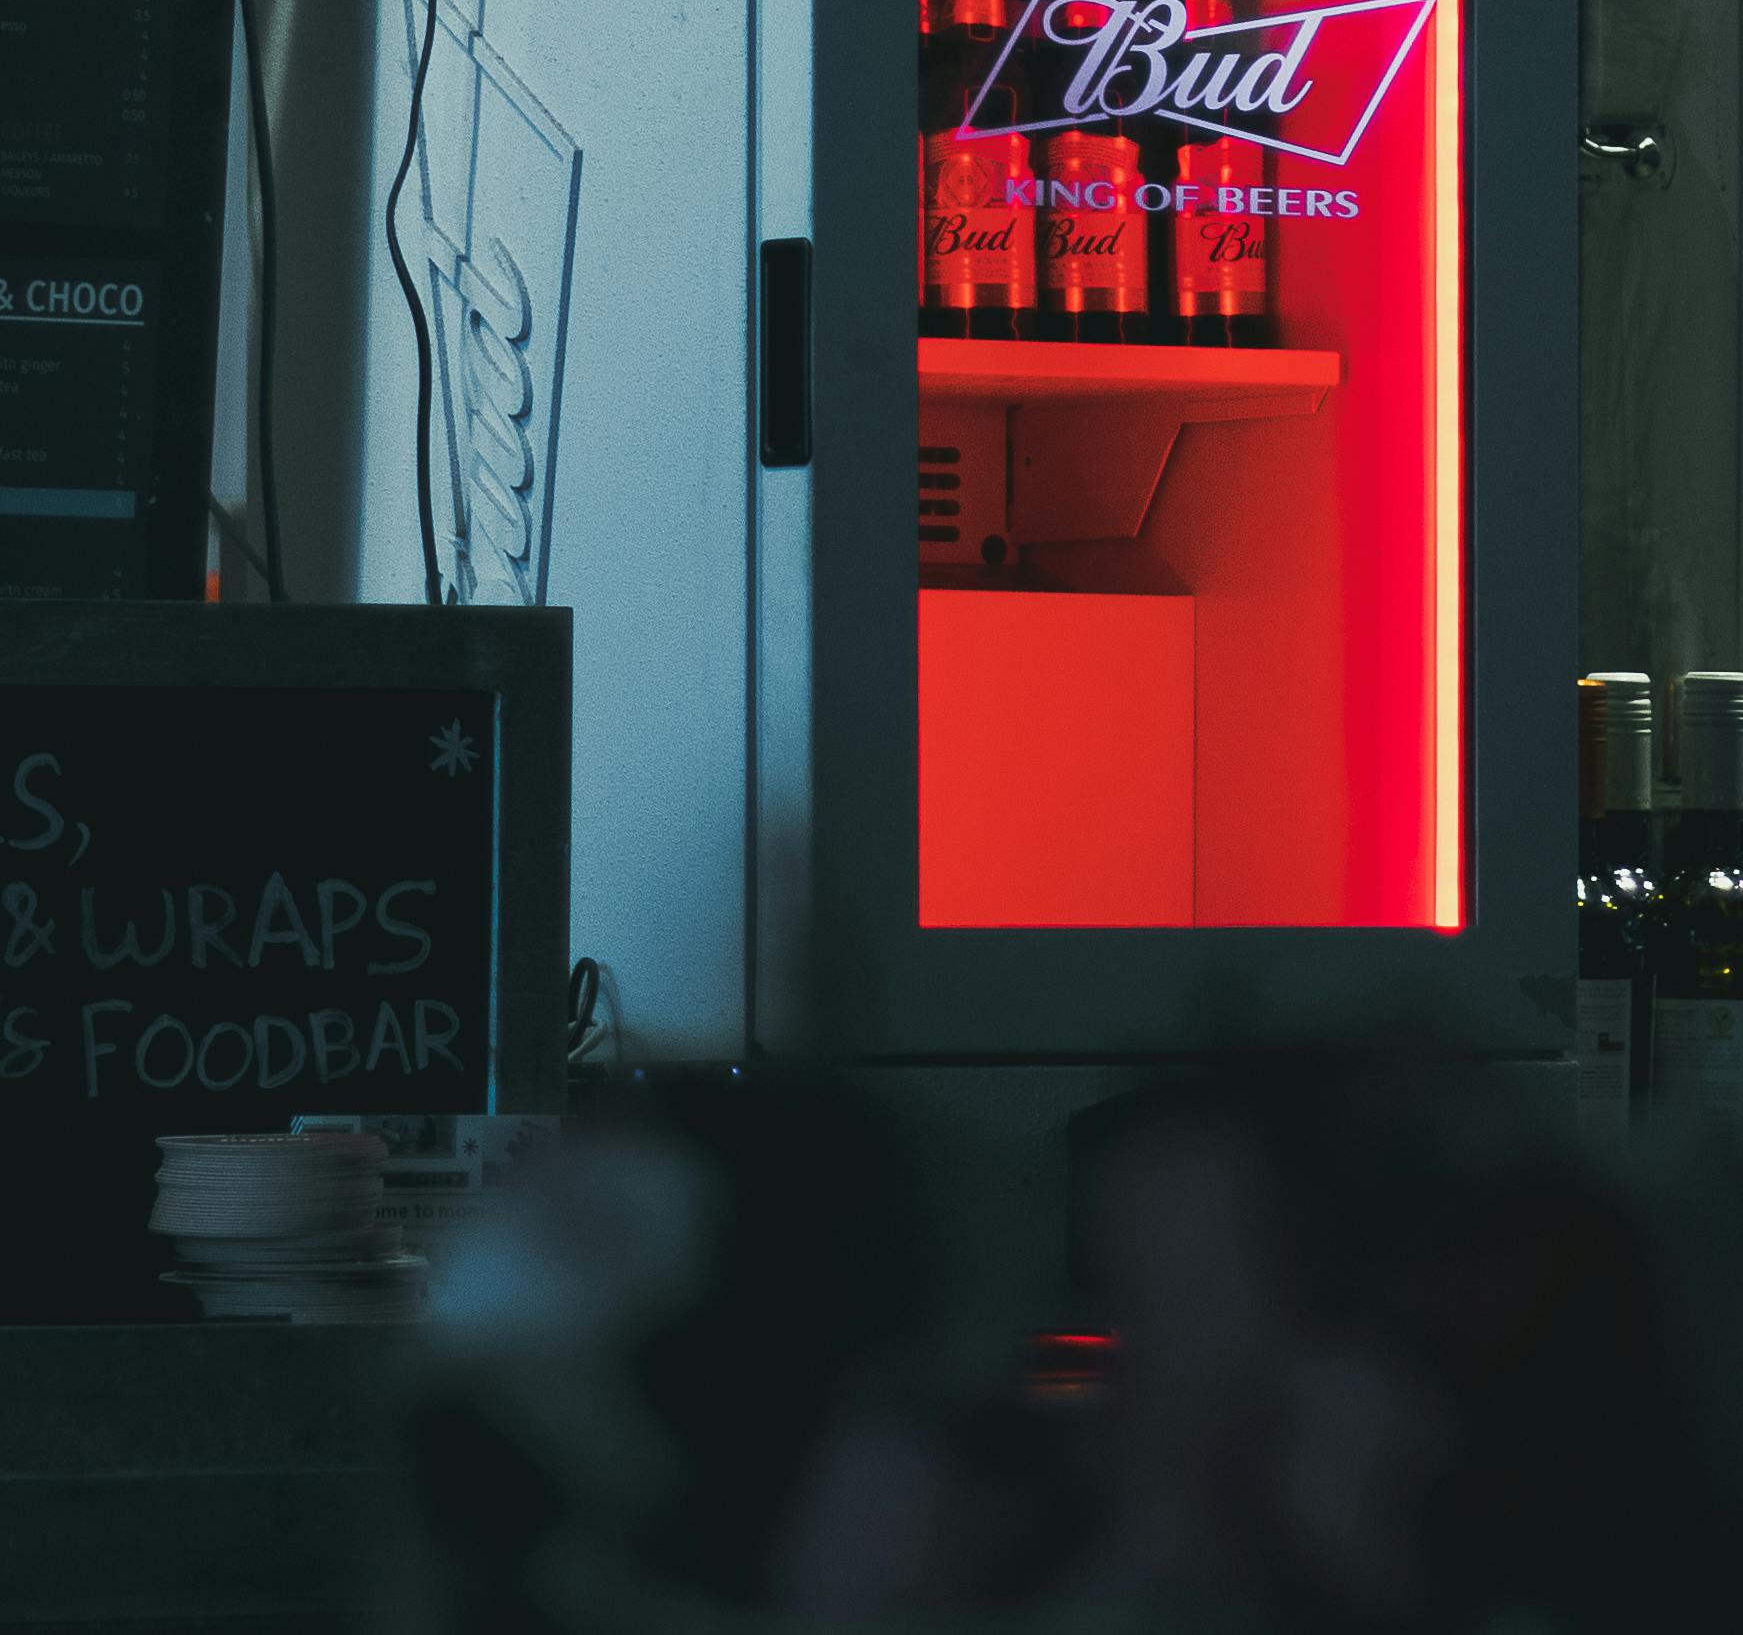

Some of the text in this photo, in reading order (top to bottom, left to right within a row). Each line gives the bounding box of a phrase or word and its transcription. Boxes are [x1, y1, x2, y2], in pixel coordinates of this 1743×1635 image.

[1004, 178, 1361, 219] KING OF BEERS
[925, 213, 1017, 256] Bud
[1046, 217, 1126, 260] Bud
[26, 280, 144, 316] CHOCO
[1, 882, 59, 963] &
[79, 870, 437, 975] WRAPS
[79, 1000, 465, 1100] FOODBAR
